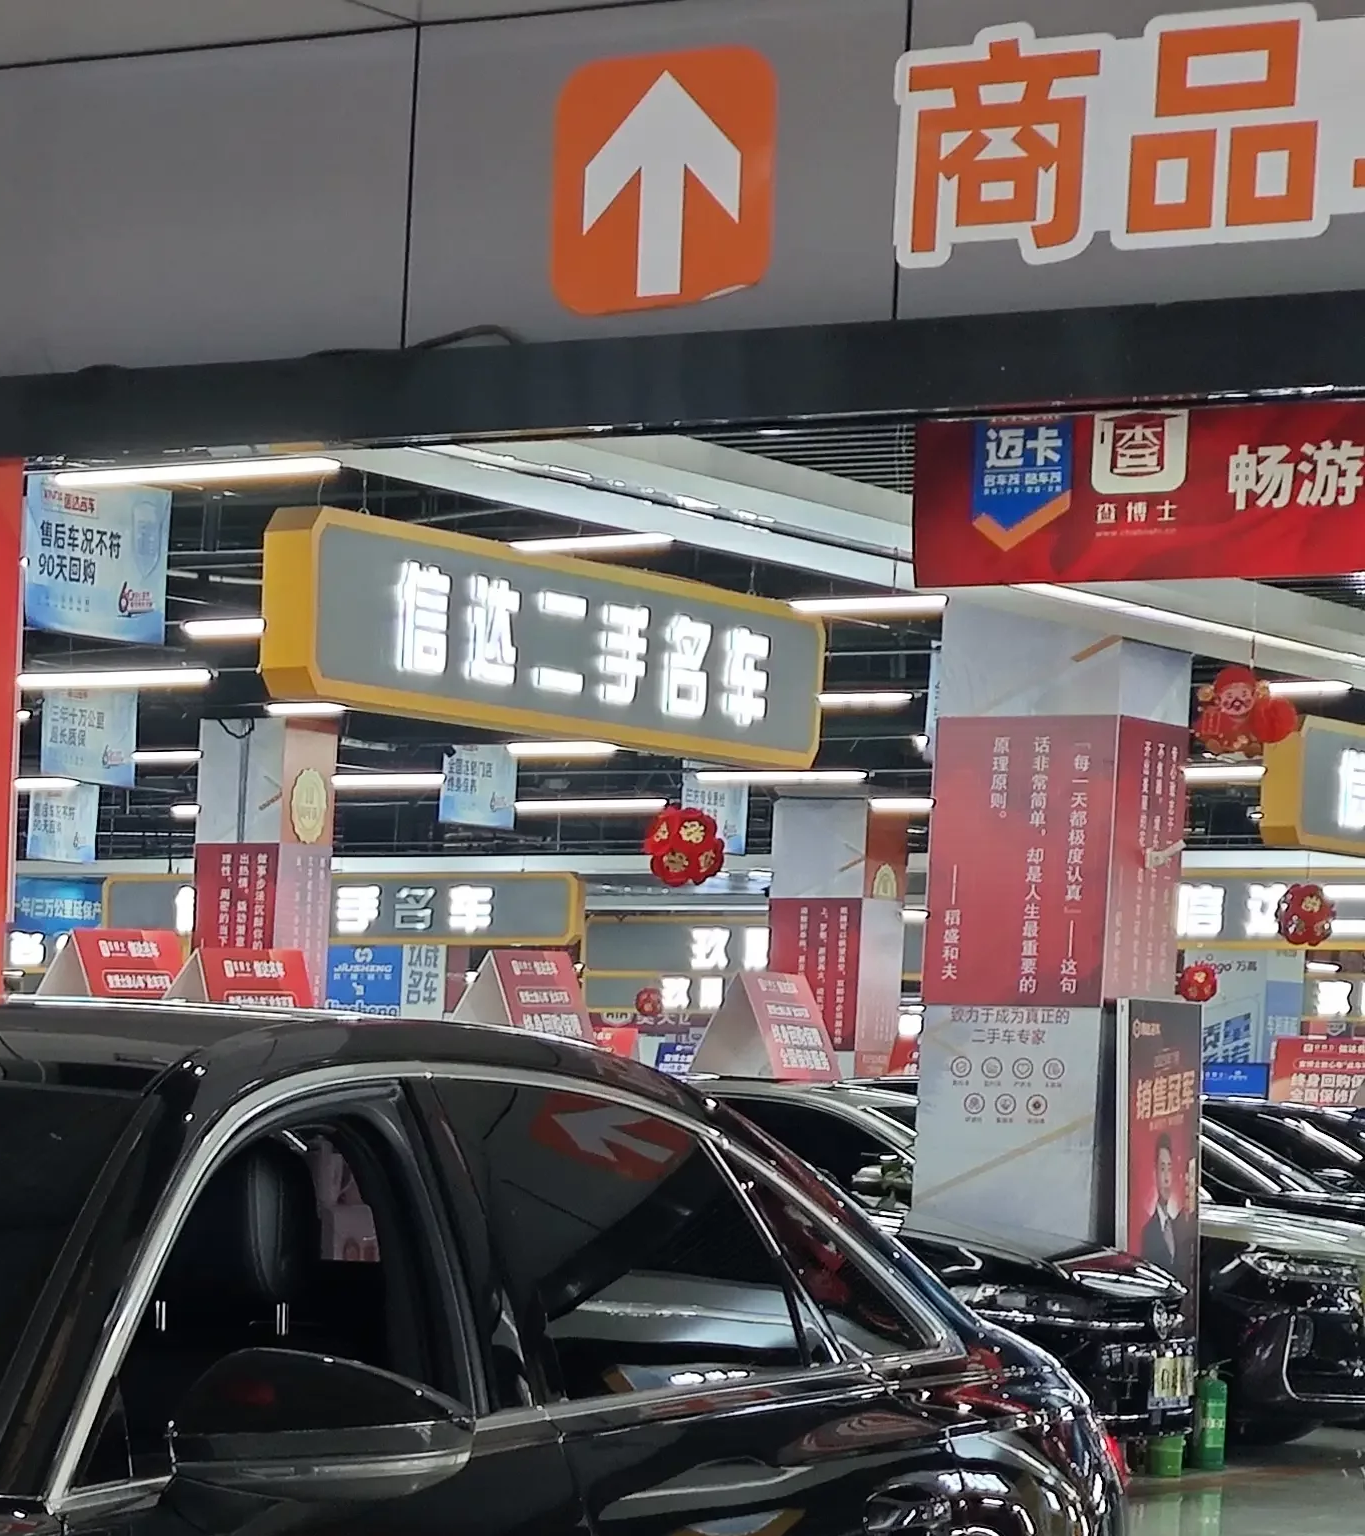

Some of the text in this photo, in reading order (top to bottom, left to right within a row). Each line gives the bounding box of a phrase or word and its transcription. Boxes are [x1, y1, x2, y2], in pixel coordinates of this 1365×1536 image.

[909, 19, 1365, 254] 商品
[985, 427, 1062, 468] 迈卡
[1227, 439, 1365, 511] 畅游
[1096, 500, 1177, 524] 查博士
[40, 520, 121, 559] 售后车况不符
[39, 553, 96, 585] 90天回购
[396, 559, 769, 726] 信达二手名车
[950, 1007, 1070, 1024] 致力于成为真正的
[971, 1028, 1046, 1045] 二手车专家
